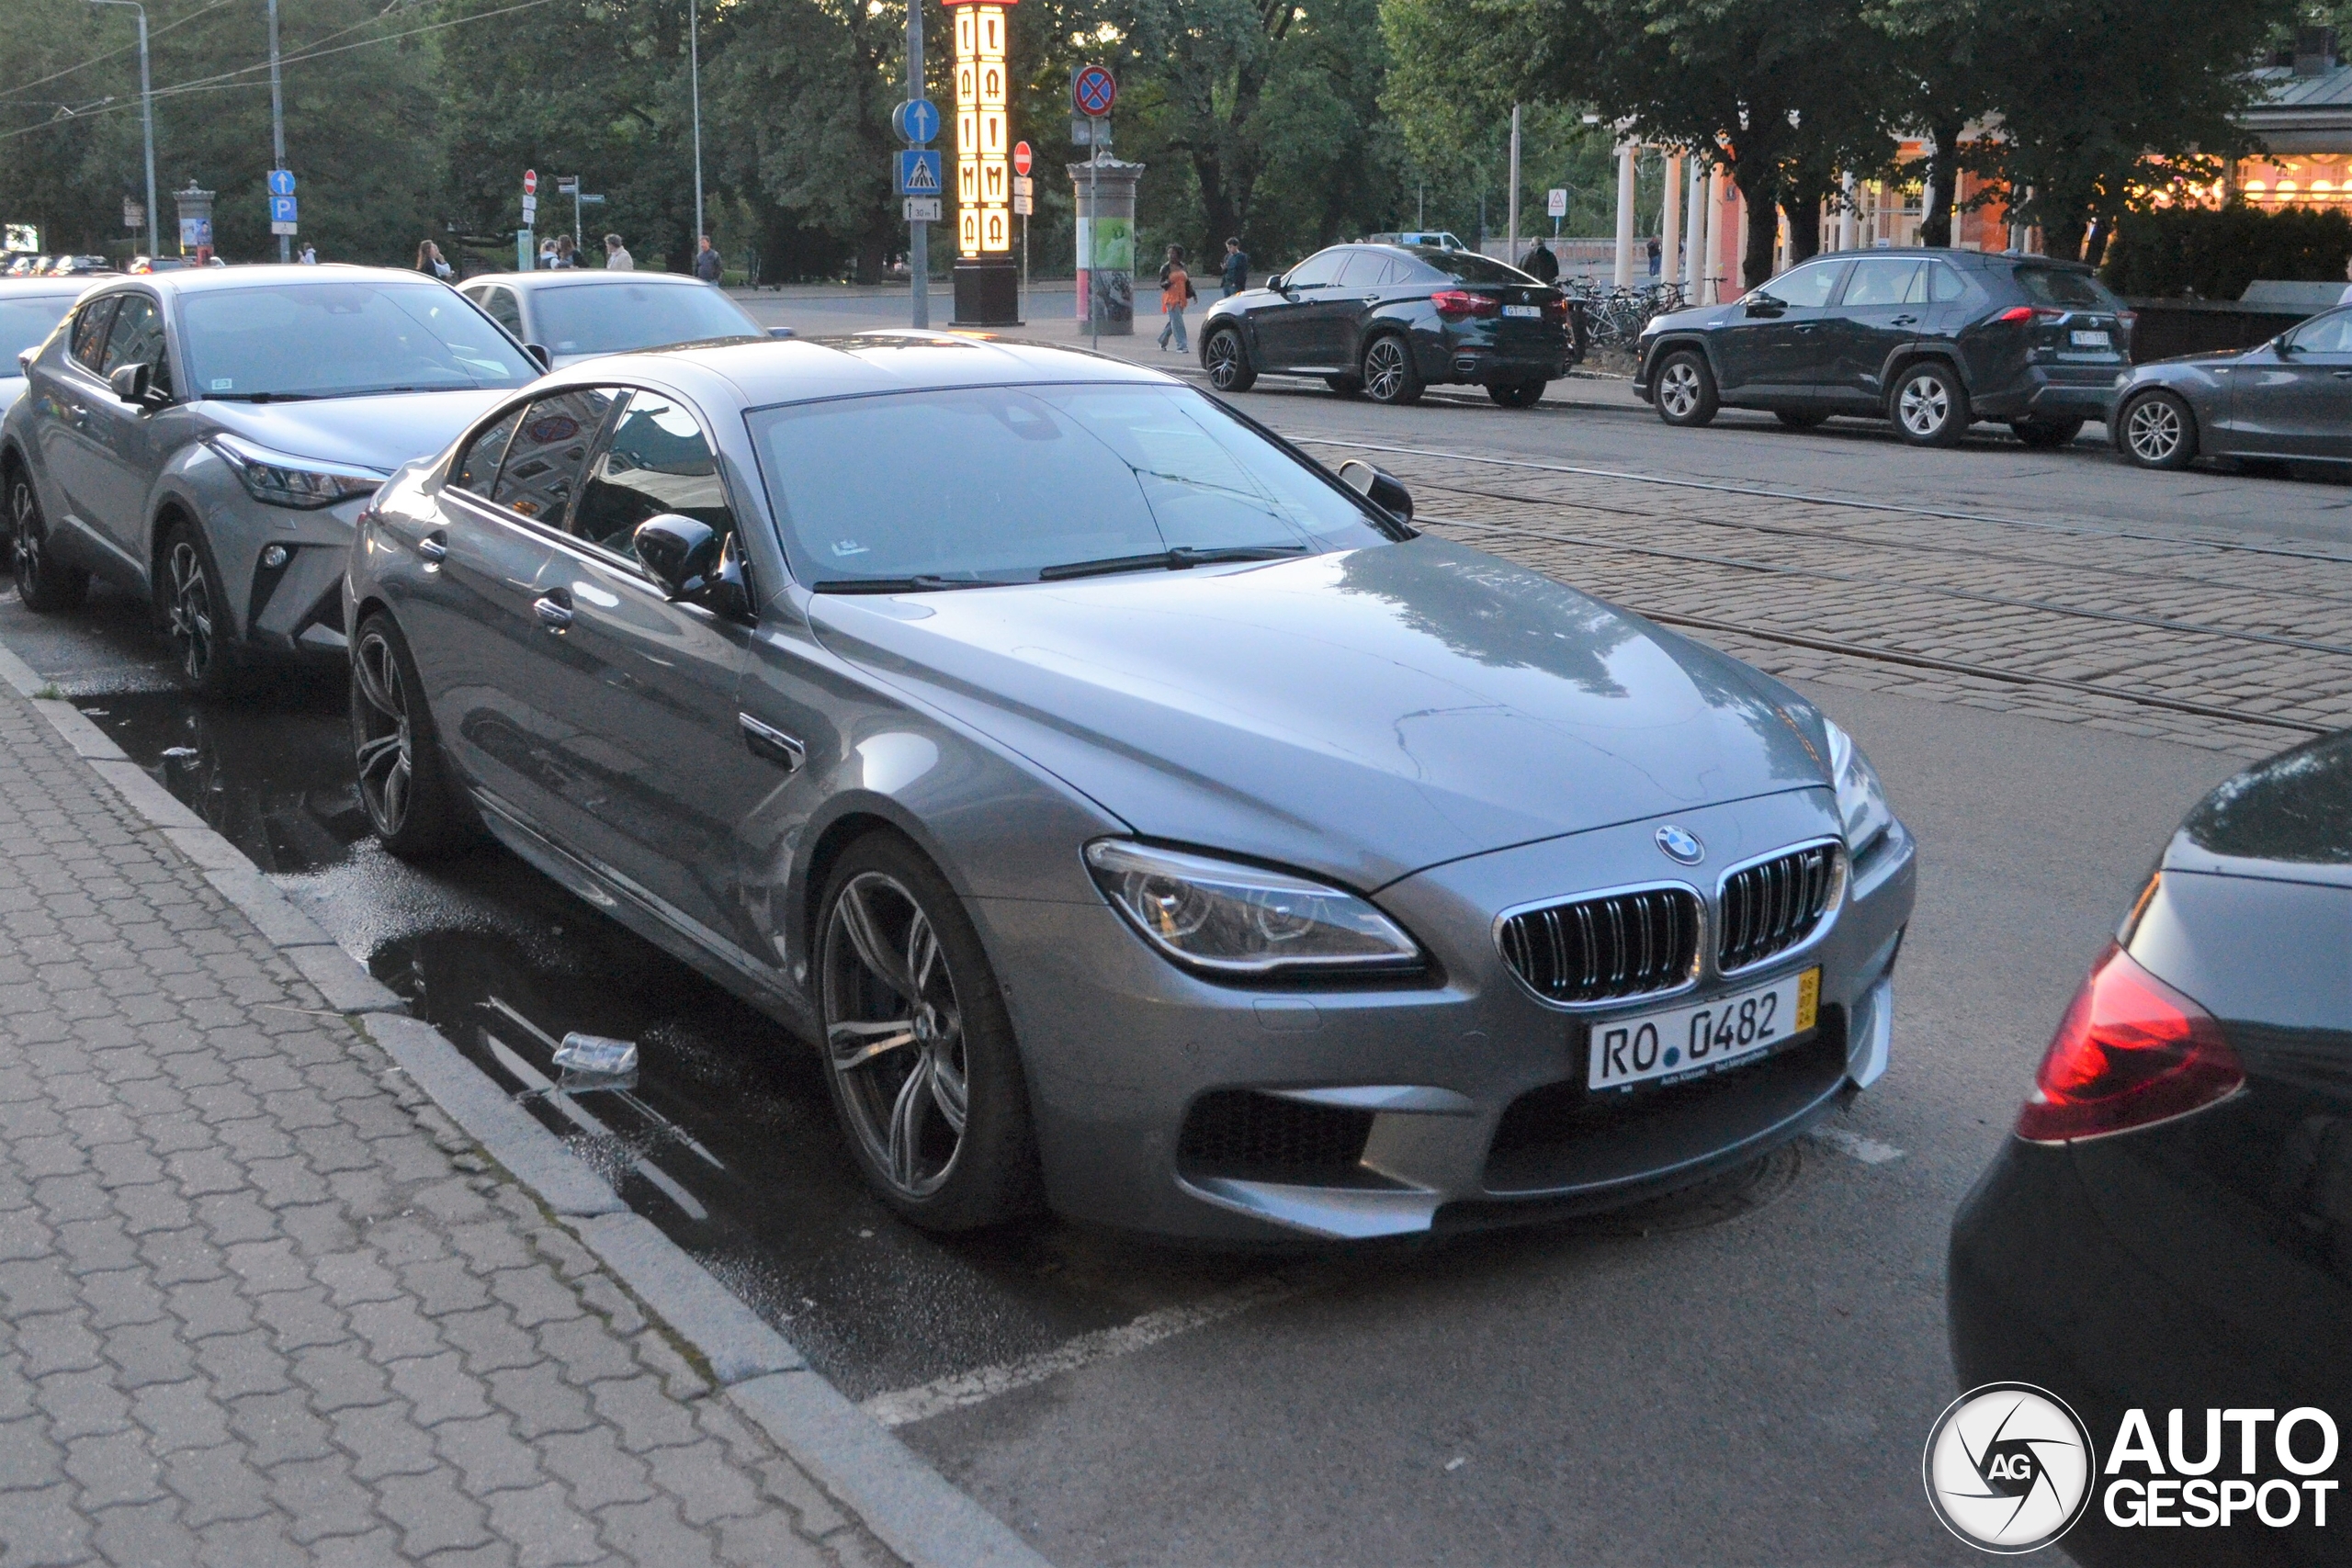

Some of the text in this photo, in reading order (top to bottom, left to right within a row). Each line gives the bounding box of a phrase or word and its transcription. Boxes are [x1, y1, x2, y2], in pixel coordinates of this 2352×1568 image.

[961, 20, 975, 244] LAIMA
[985, 19, 1003, 244] LAIMA
[277, 199, 291, 219] P
[915, 209, 923, 217] 30
[1602, 991, 1778, 1078] RO 0482
